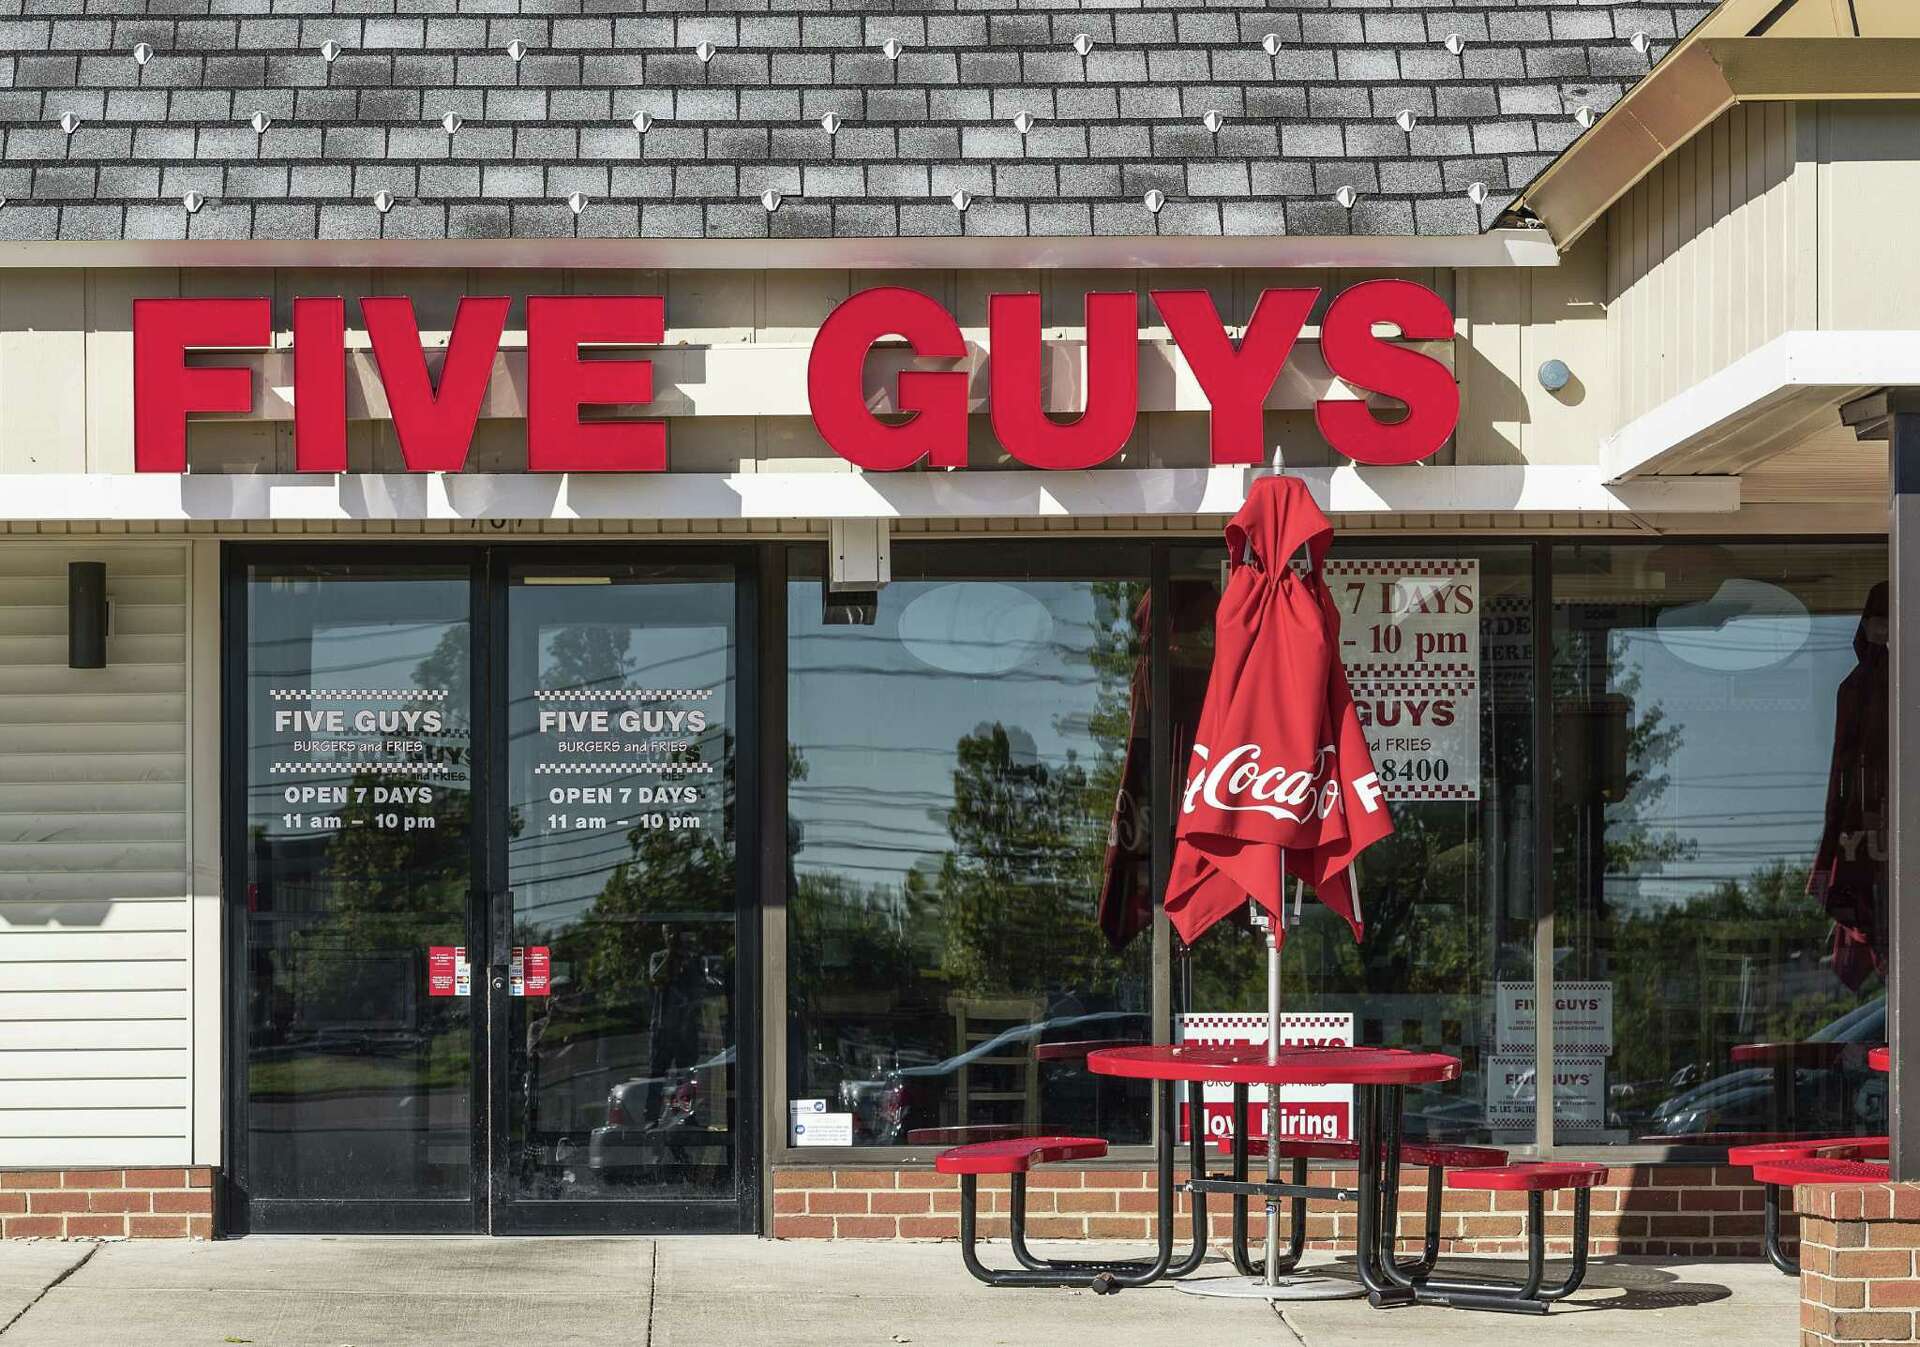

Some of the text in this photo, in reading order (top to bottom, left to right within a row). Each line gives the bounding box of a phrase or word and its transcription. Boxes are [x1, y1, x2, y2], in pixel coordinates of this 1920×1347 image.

[134, 280, 1461, 473] FIVE GUYS
[1345, 582, 1474, 615] 7 DAYS
[1368, 624, 1401, 654] 10
[1415, 631, 1468, 663] pm
[275, 710, 442, 732] FIVE GUYS
[539, 710, 706, 732] FIVE GUYS
[294, 741, 423, 752] BURGERS and FRIES
[558, 741, 687, 752] BURGERS and FRIES
[1386, 738, 1432, 751] FRIES
[284, 786, 432, 804] OPEN 7 DAYS
[548, 787, 696, 804] OPEN 7 DAYS
[283, 814, 301, 828] 11
[310, 816, 342, 828] am
[375, 814, 398, 828] 10
[404, 815, 435, 831] pm
[547, 814, 565, 828] 11
[574, 816, 606, 829] am
[639, 814, 662, 829] 10
[668, 816, 699, 832] pm
[1555, 999, 1599, 1010] GUYS
